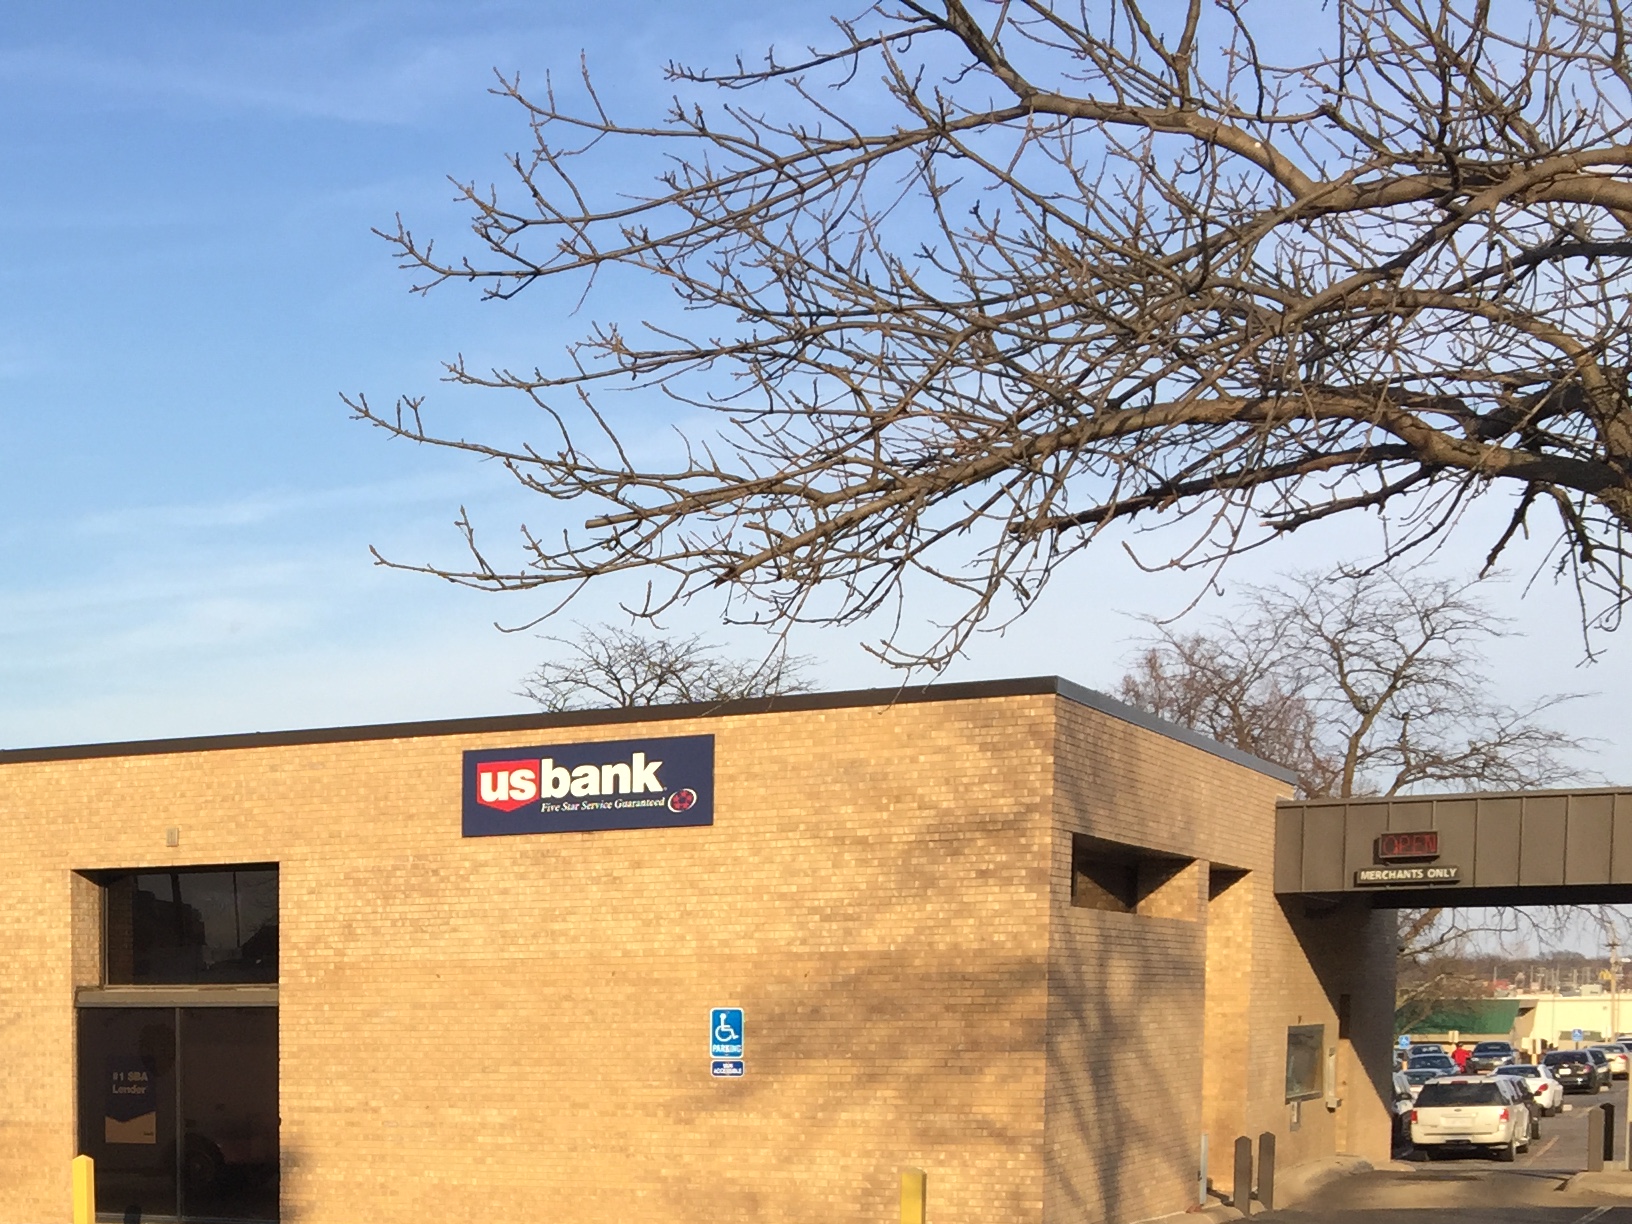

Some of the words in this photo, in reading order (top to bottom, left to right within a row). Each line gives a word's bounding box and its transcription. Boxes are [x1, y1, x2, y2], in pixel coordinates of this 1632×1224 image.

[540, 801, 561, 813] Five
[561, 801, 580, 812] Star
[580, 799, 613, 811] Service
[614, 797, 666, 809] Guaranteed
[1382, 834, 1436, 856] OPEN
[1360, 868, 1424, 881] MERCHANTS
[1426, 867, 1458, 878] ONLY
[712, 1044, 743, 1053] PARKING
[127, 1071, 149, 1082] SBA
[112, 1084, 147, 1095] Lender
